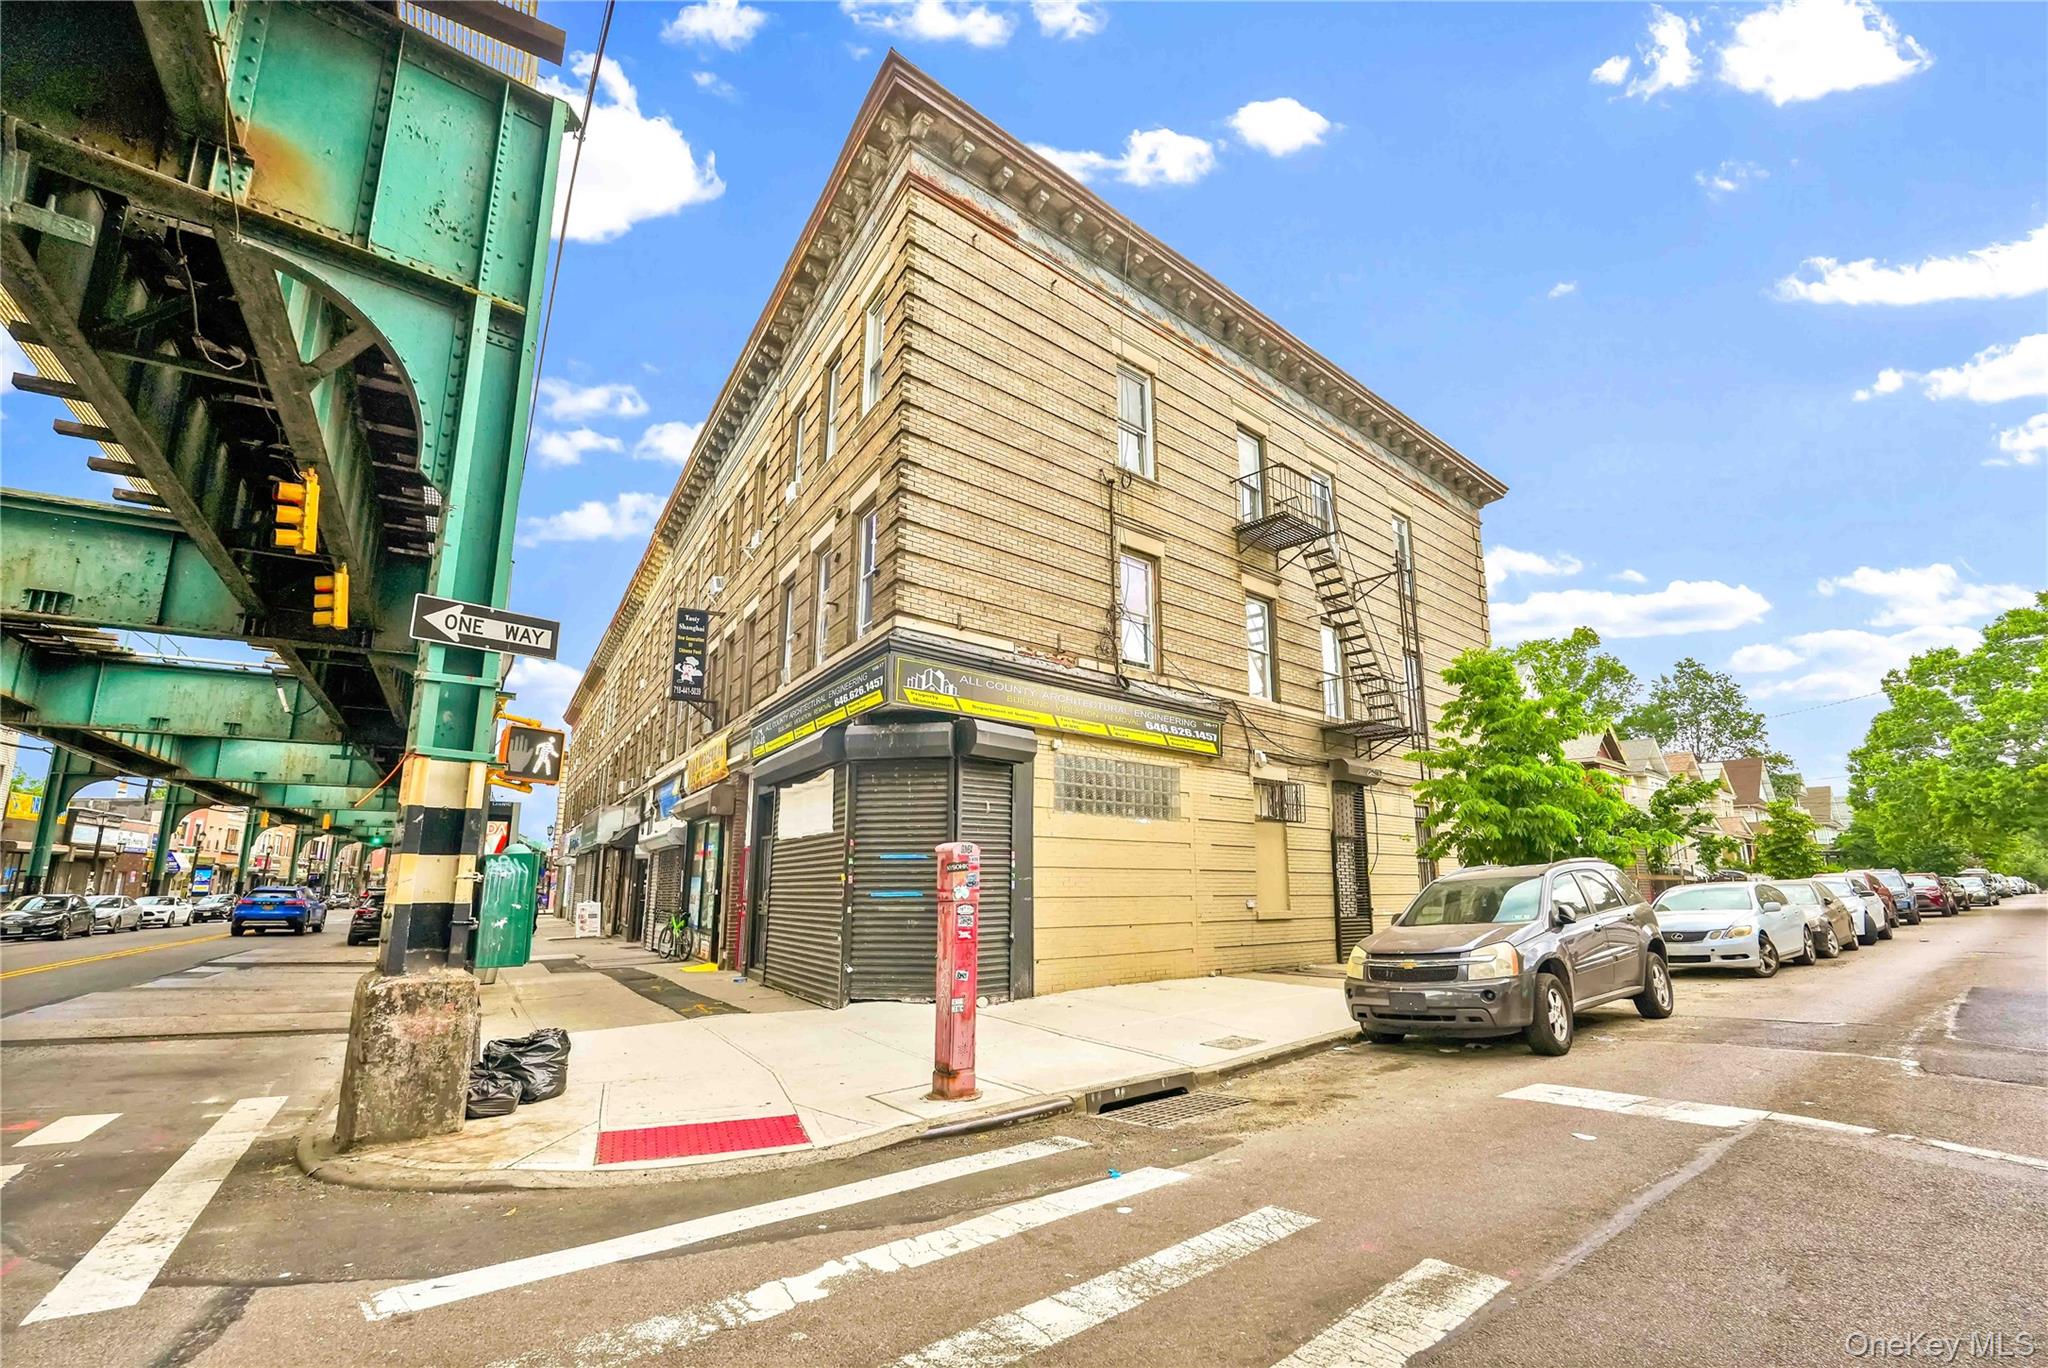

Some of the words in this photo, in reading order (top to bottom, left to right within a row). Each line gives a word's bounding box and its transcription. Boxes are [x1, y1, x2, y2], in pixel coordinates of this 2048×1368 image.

[445, 614, 485, 635] ONE
[505, 624, 545, 645] WAY
[679, 623, 705, 632] Shanghai
[685, 614, 700, 624] Tasty
[828, 672, 868, 699] ENGINEERING
[834, 675, 884, 707] 646.626.1457
[910, 690, 939, 701] Property
[912, 697, 955, 709] Management
[960, 675, 983, 688] ALL
[985, 680, 1037, 698] COUNTY
[1041, 691, 1130, 715] ARCHITECTURAL
[1134, 709, 1197, 728] ENGINEERING
[1006, 695, 1050, 709] BUILDING
[1055, 704, 1100, 719] VIOLATION
[1104, 713, 1141, 726] REMOVAL
[1145, 721, 1218, 742] 646.626.1457
